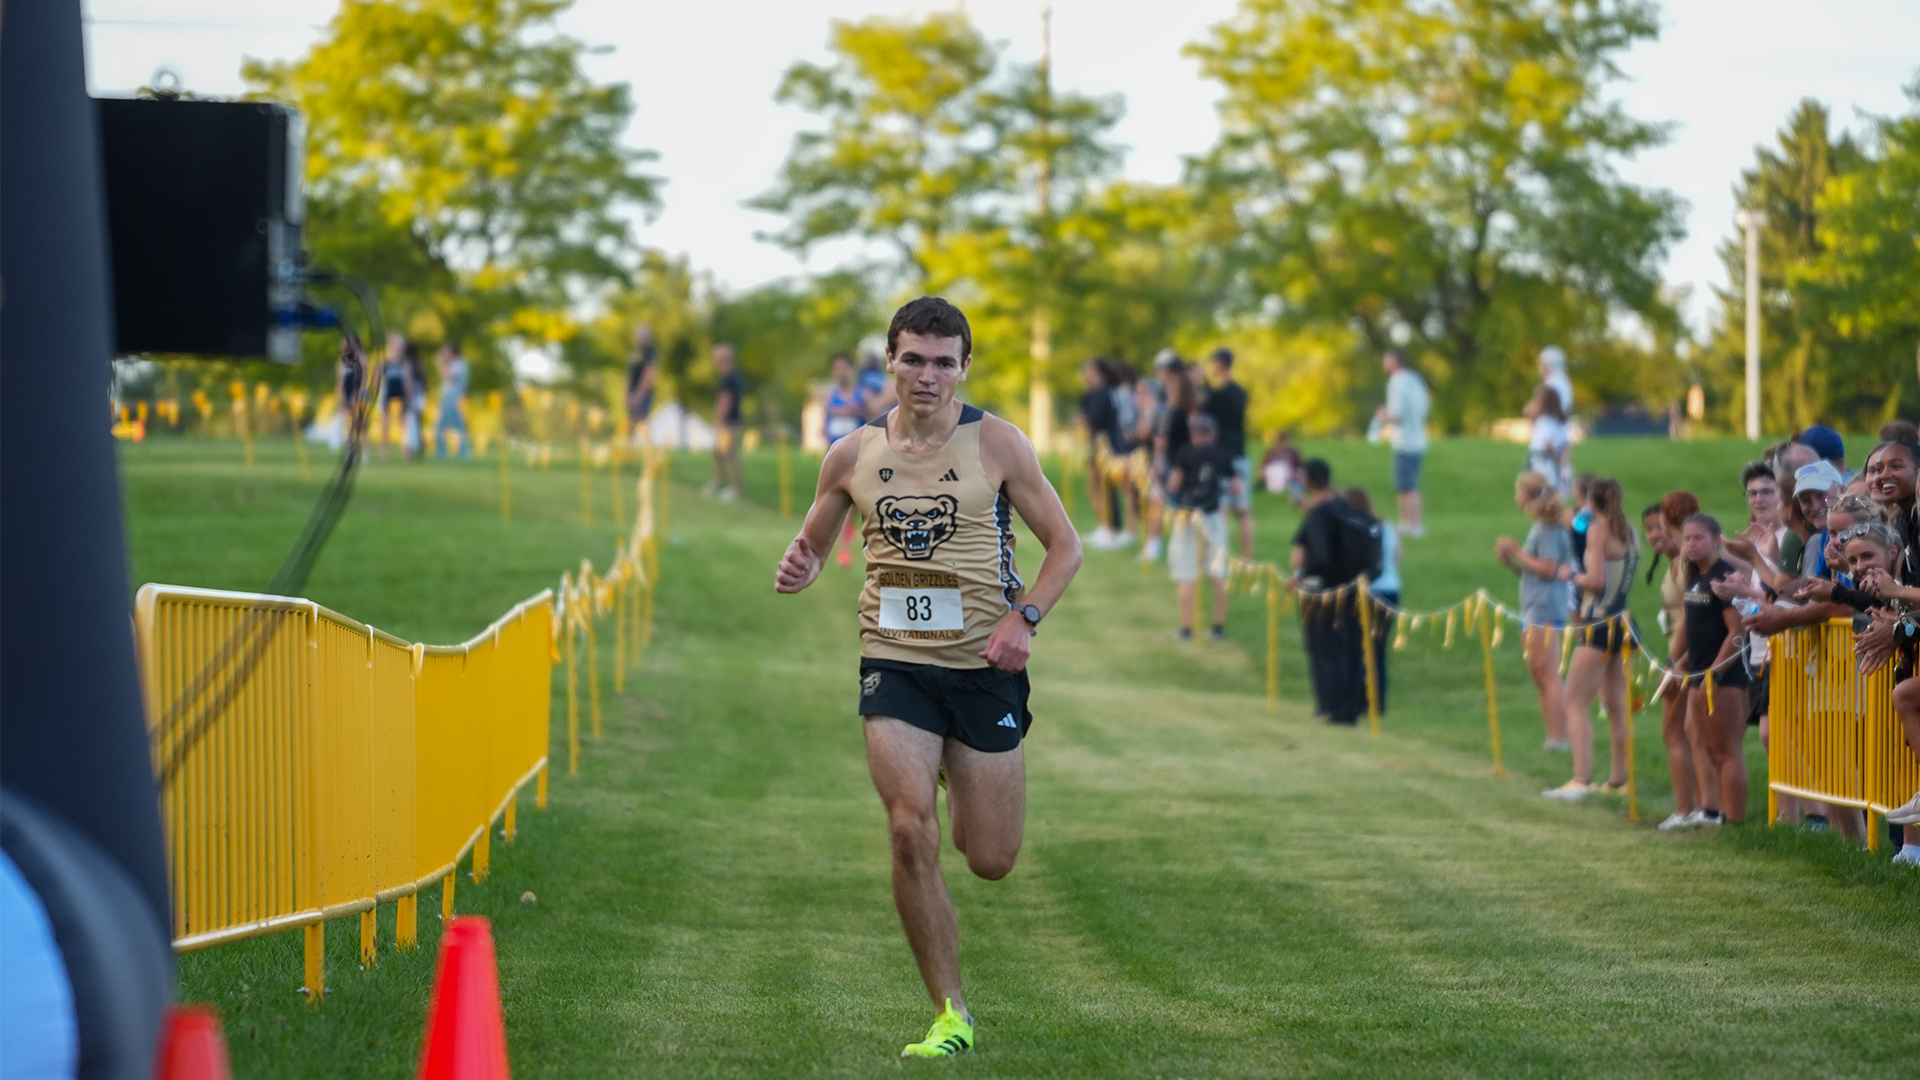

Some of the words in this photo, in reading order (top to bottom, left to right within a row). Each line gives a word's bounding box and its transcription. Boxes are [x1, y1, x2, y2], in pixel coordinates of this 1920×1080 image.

[879, 572, 911, 587] GOLDEN
[913, 573, 959, 588] GRIZZLIES
[906, 595, 932, 621] 83
[879, 628, 952, 639] INVITATIONAL
